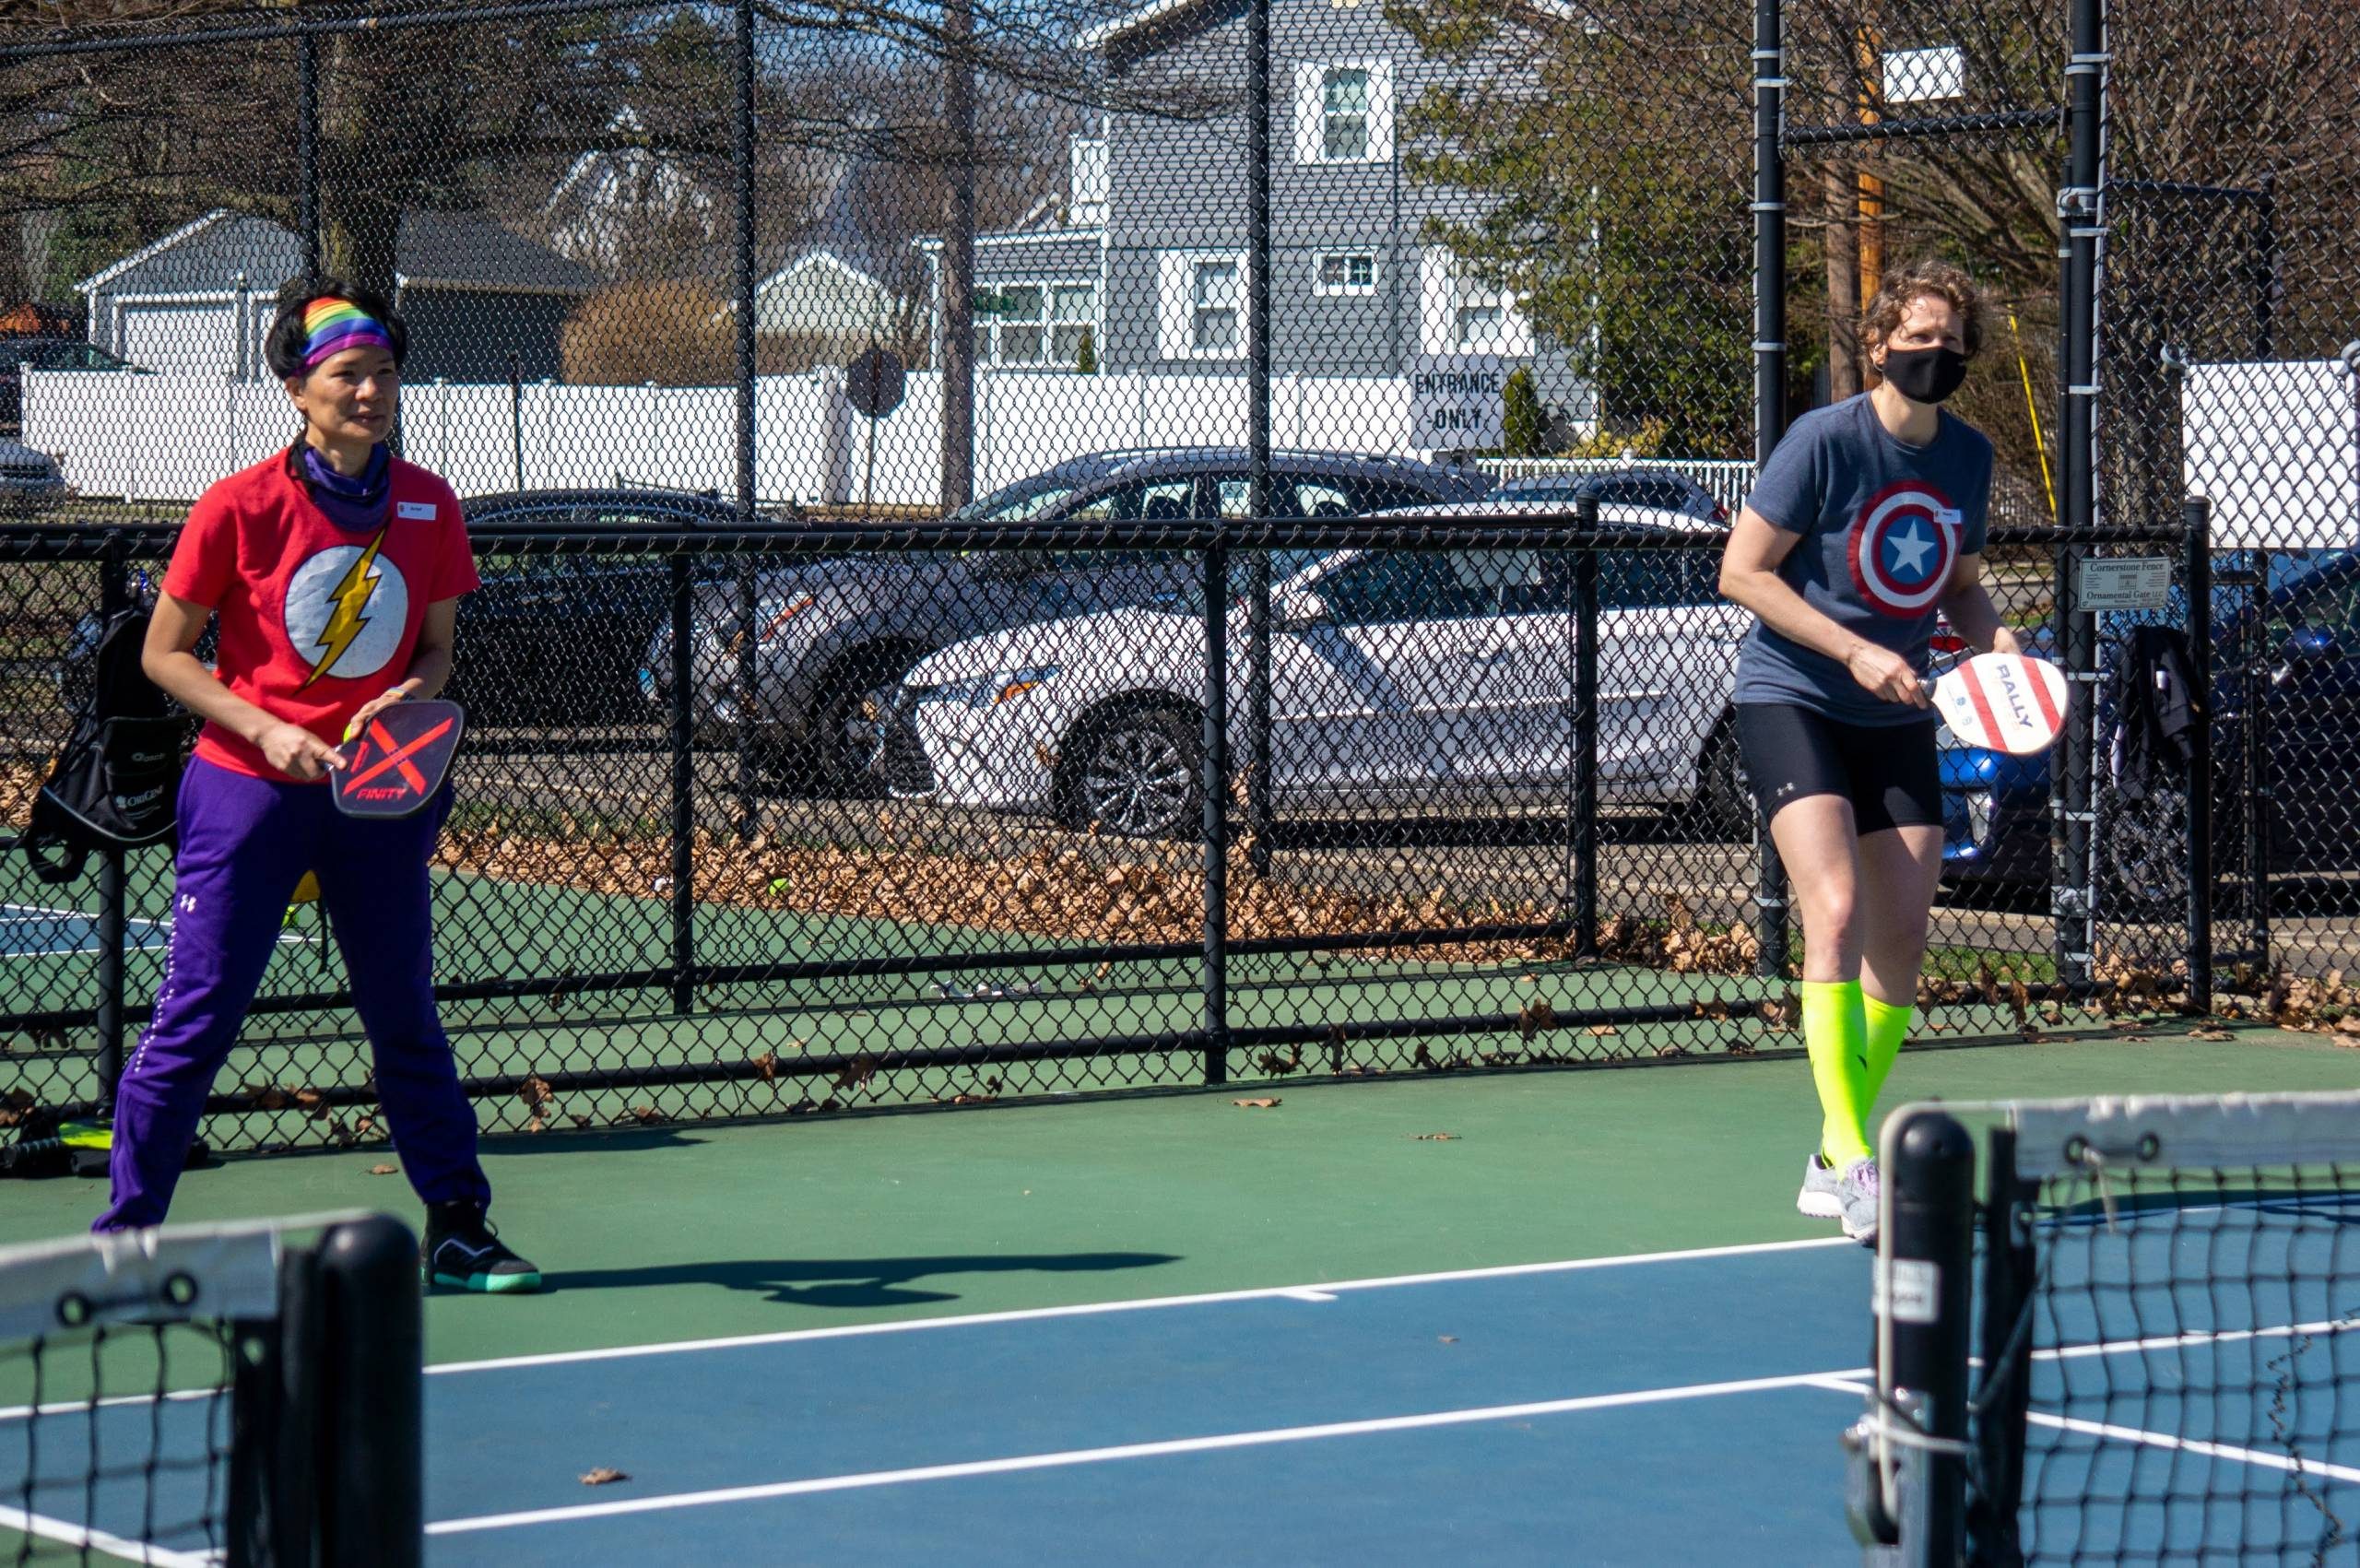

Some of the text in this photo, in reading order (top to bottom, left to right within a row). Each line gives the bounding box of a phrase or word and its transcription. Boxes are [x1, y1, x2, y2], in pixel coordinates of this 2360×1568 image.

[1414, 372, 1501, 395] ENTRANCE
[2090, 561, 2164, 572] Cornerstone Fence
[2086, 590, 2131, 600] Ornamental
[2133, 590, 2151, 598] Gate
[1996, 663, 2034, 728] RALLY
[356, 785, 407, 801] FINITY
